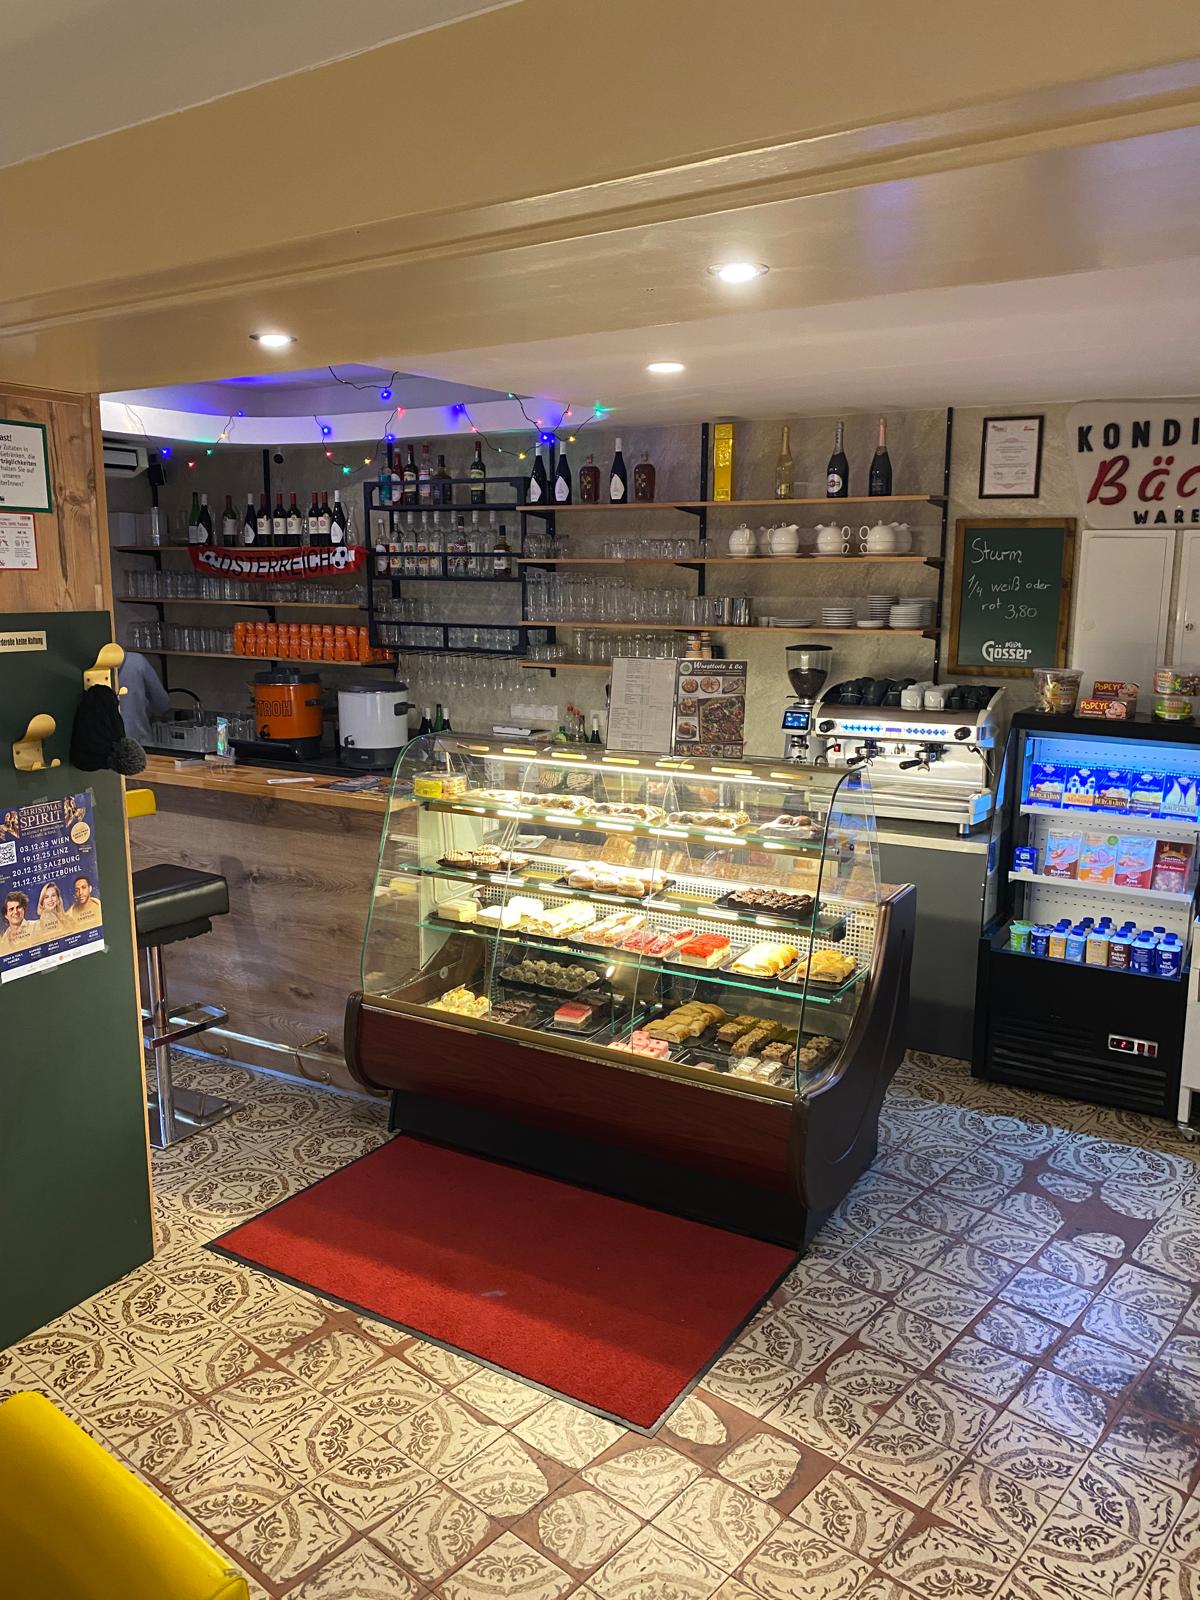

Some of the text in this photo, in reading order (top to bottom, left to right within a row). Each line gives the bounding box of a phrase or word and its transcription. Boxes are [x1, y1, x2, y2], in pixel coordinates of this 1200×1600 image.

[970, 537, 1023, 564] Sturm
[991, 575, 1021, 592] weiß
[1025, 578, 1053, 590] oder
[981, 597, 1038, 620] rot 3,80
[981, 640, 1032, 663] Gösser
[256, 699, 293, 718] TROH
[19, 803, 62, 817] CHRISTMAS
[19, 810, 62, 829] SPIRIT
[19, 836, 70, 853] 03.12.25 WIEN
[22, 850, 51, 864] 19.12.25
[52, 847, 69, 857] LINZ
[12, 855, 80, 877] 20.12.25 SALZBURG
[12, 865, 83, 889] 21.12.25 KITZBÜHEL
